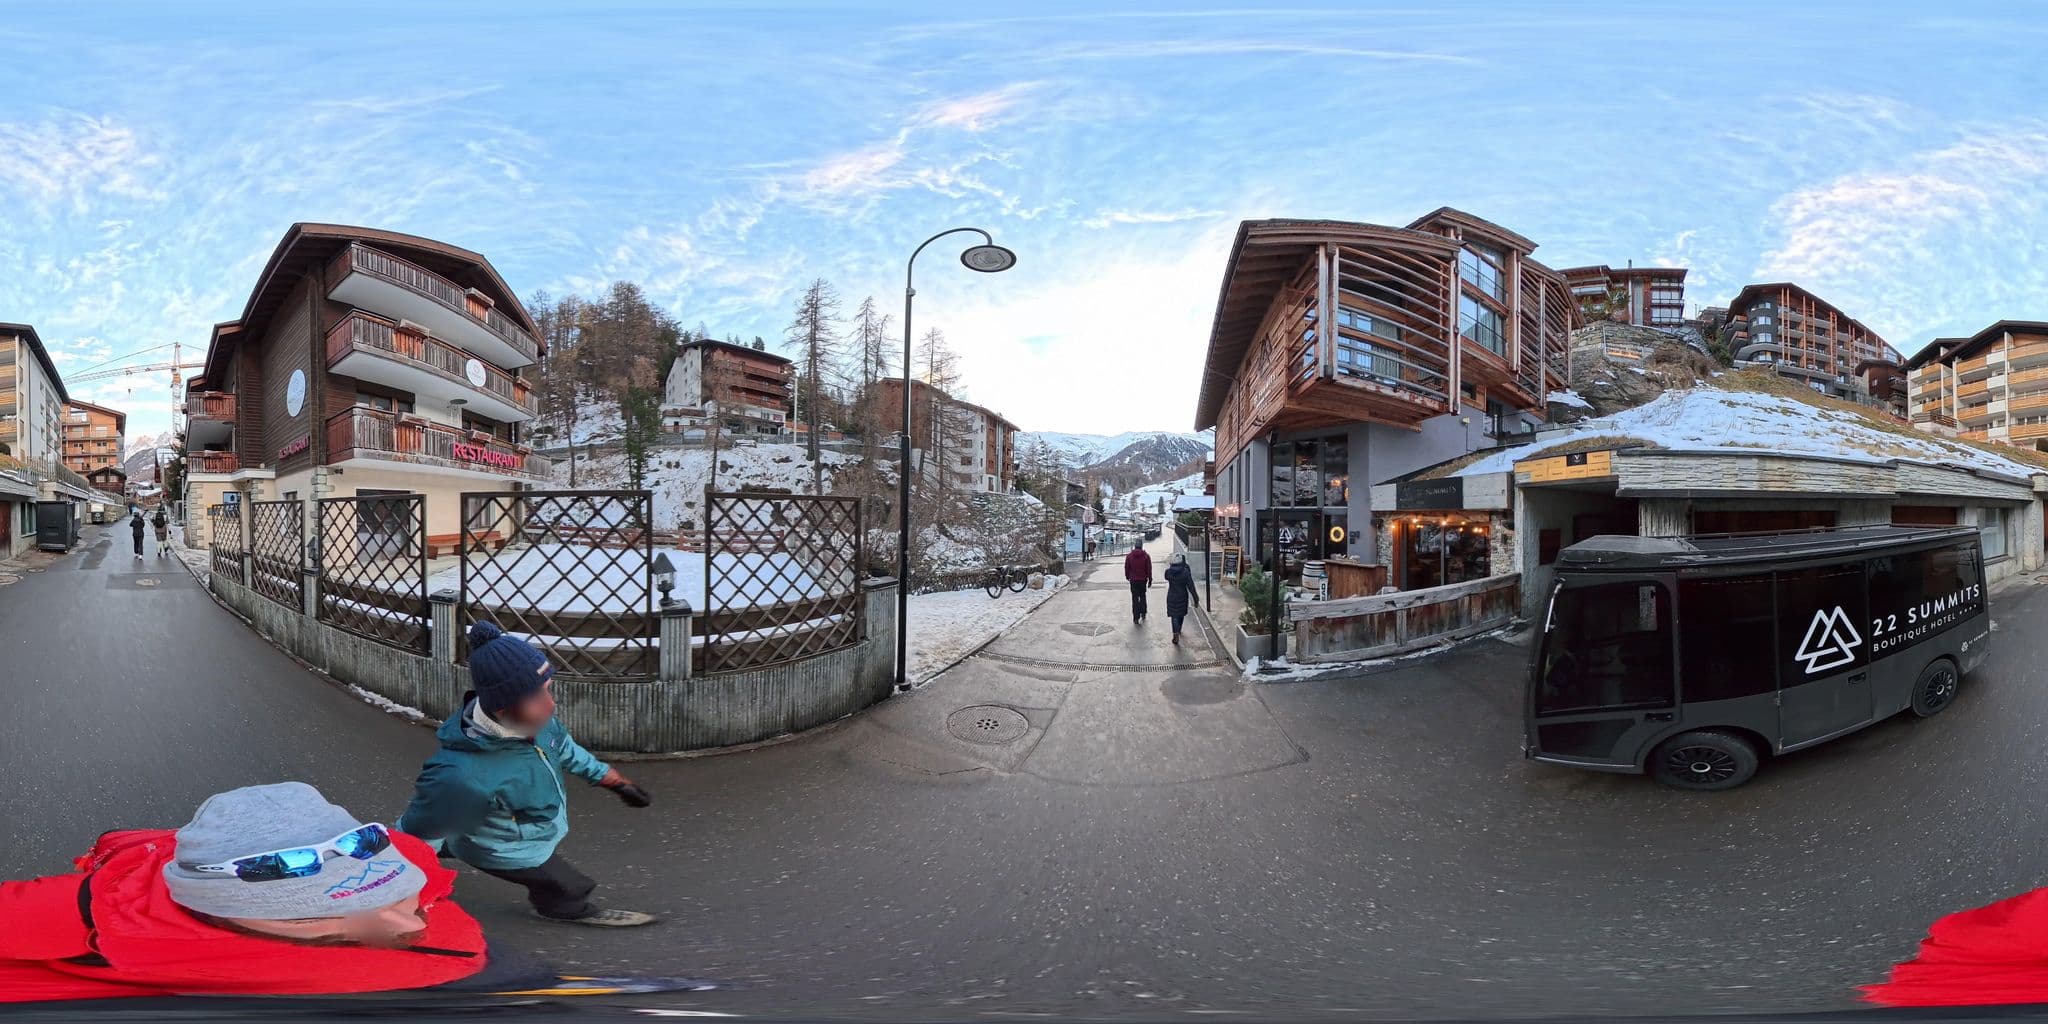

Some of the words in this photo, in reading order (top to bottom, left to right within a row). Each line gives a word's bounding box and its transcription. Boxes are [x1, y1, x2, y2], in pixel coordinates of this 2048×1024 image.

[453, 442, 519, 467] RESTAURANT
[1873, 614, 1897, 636] 22
[1908, 584, 1979, 623] SUMMITS
[1873, 625, 1927, 652] BOUTIQUE
[1931, 613, 1956, 629] HOTEL
